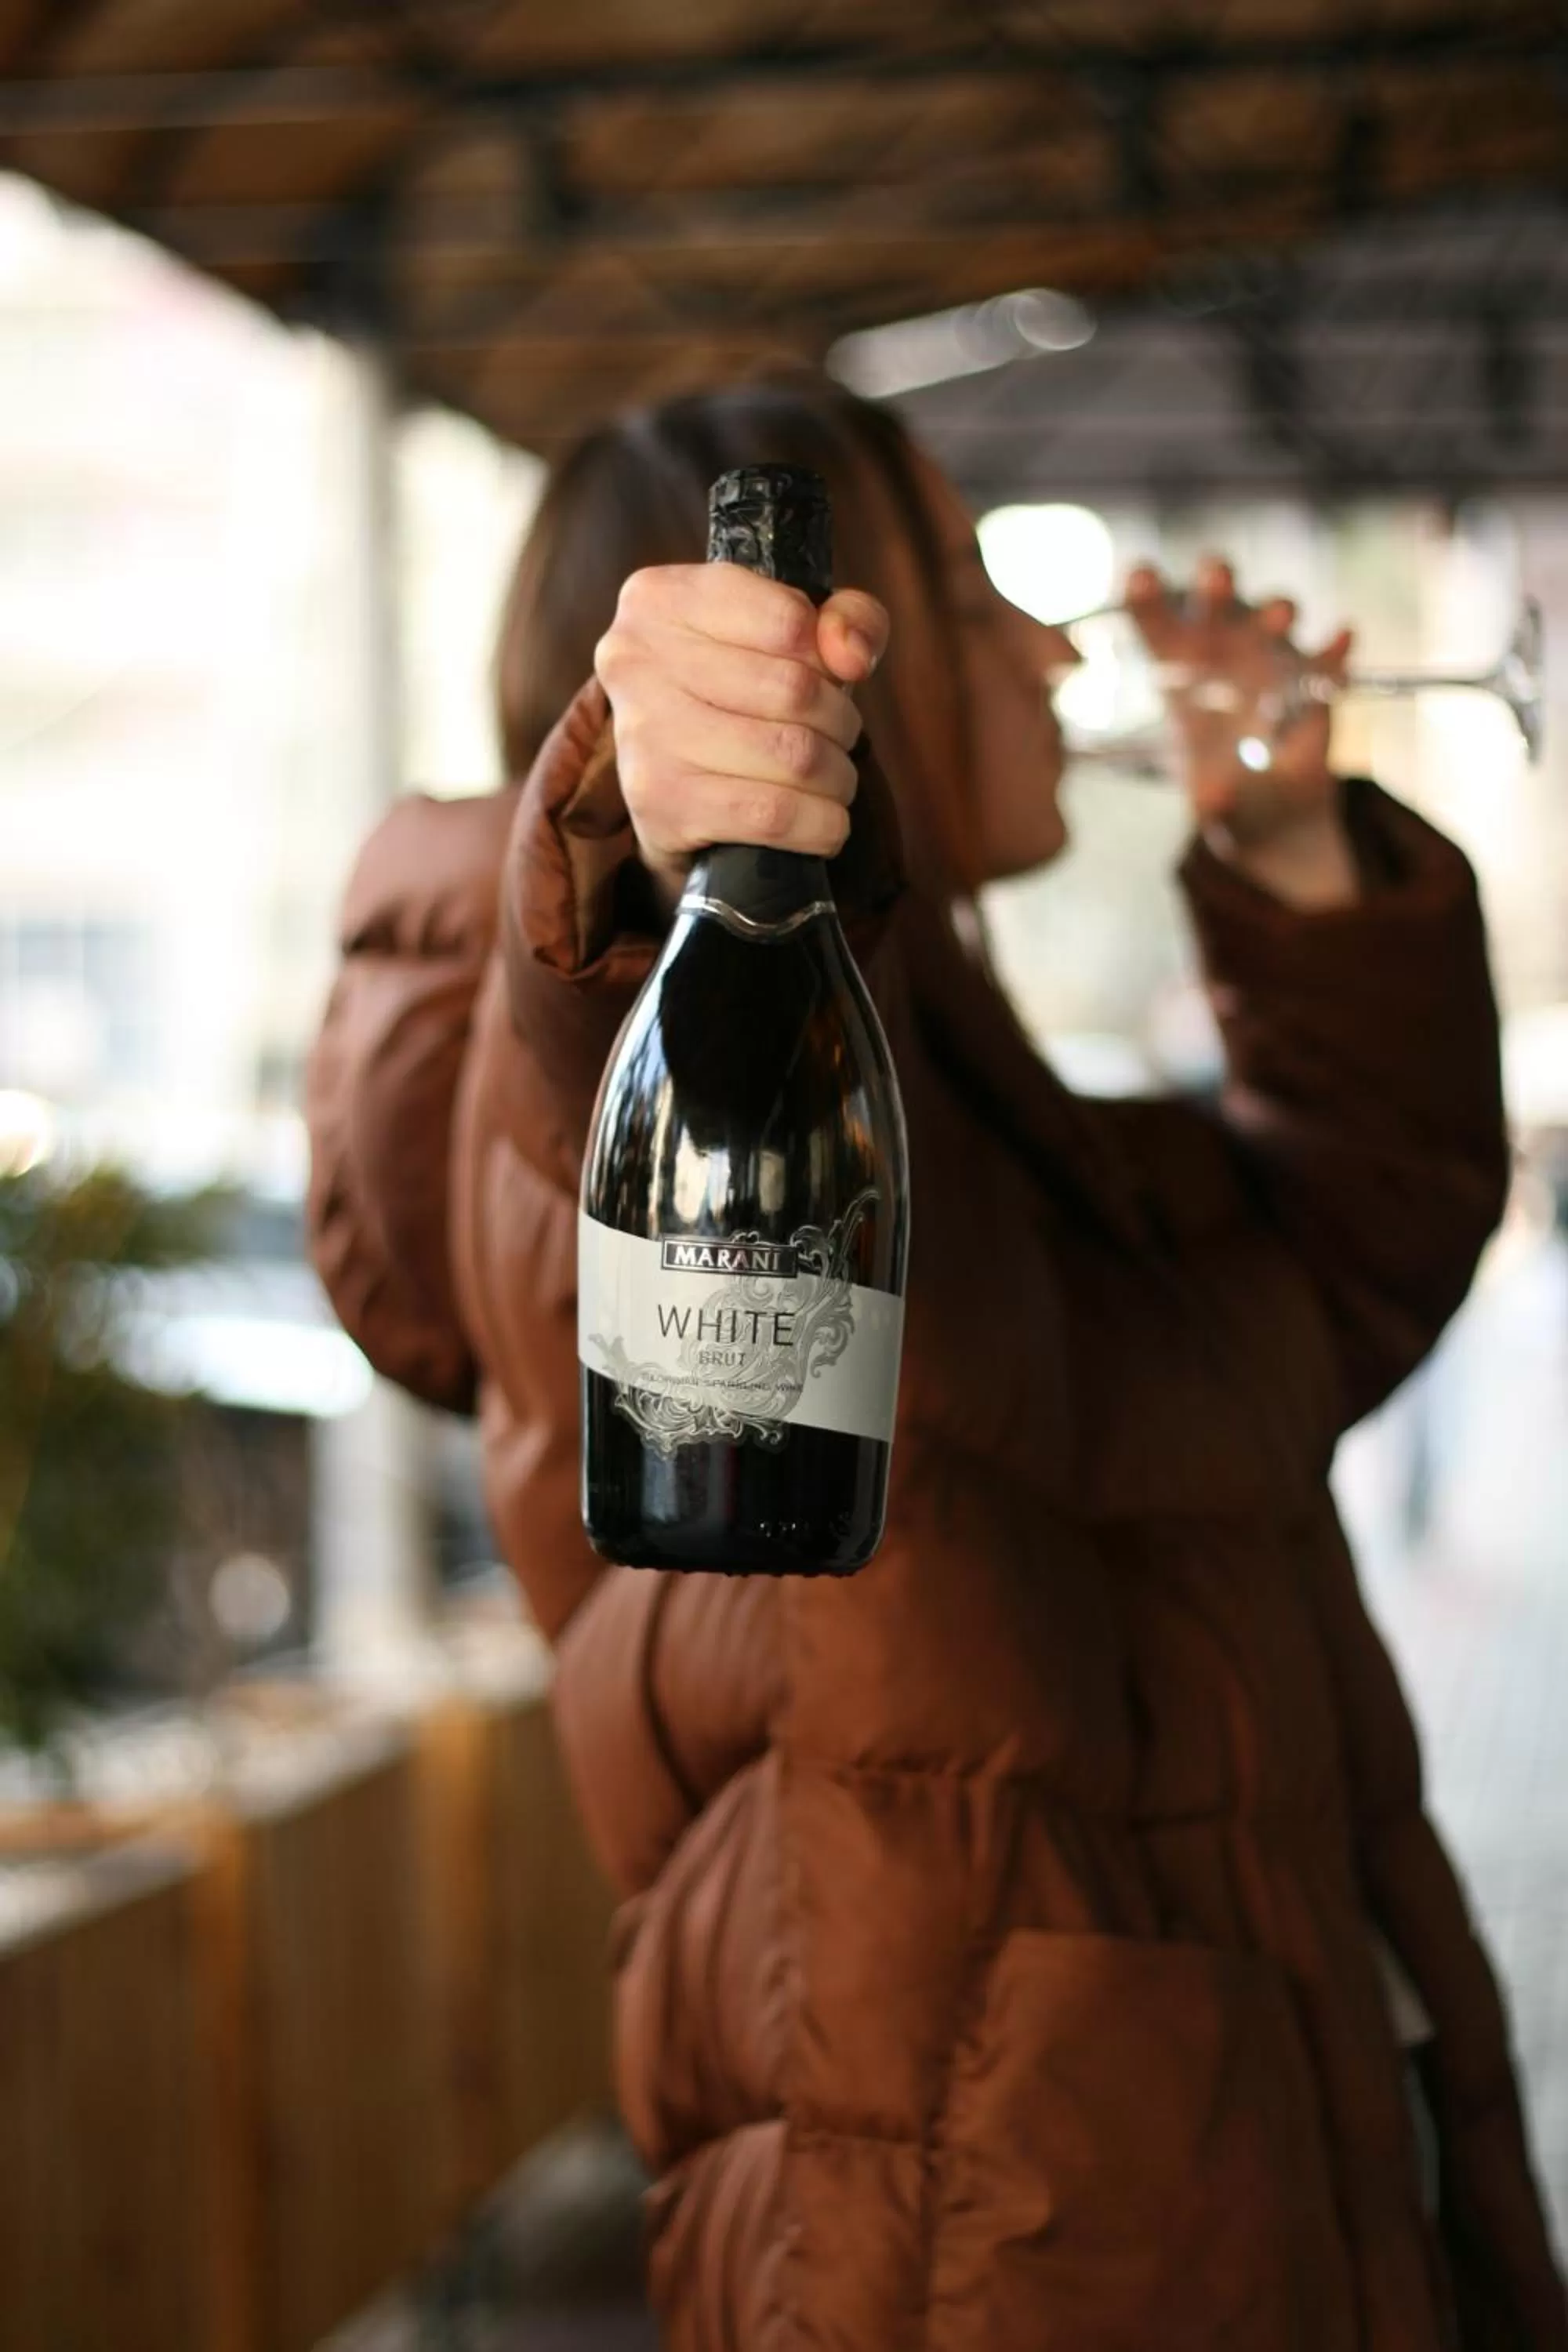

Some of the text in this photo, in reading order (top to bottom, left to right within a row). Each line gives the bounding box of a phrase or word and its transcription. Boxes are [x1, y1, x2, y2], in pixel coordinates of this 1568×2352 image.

[674, 1246, 780, 1271] MARANI
[658, 1304, 795, 1345] WHITE
[698, 1350, 747, 1367] BRUT
